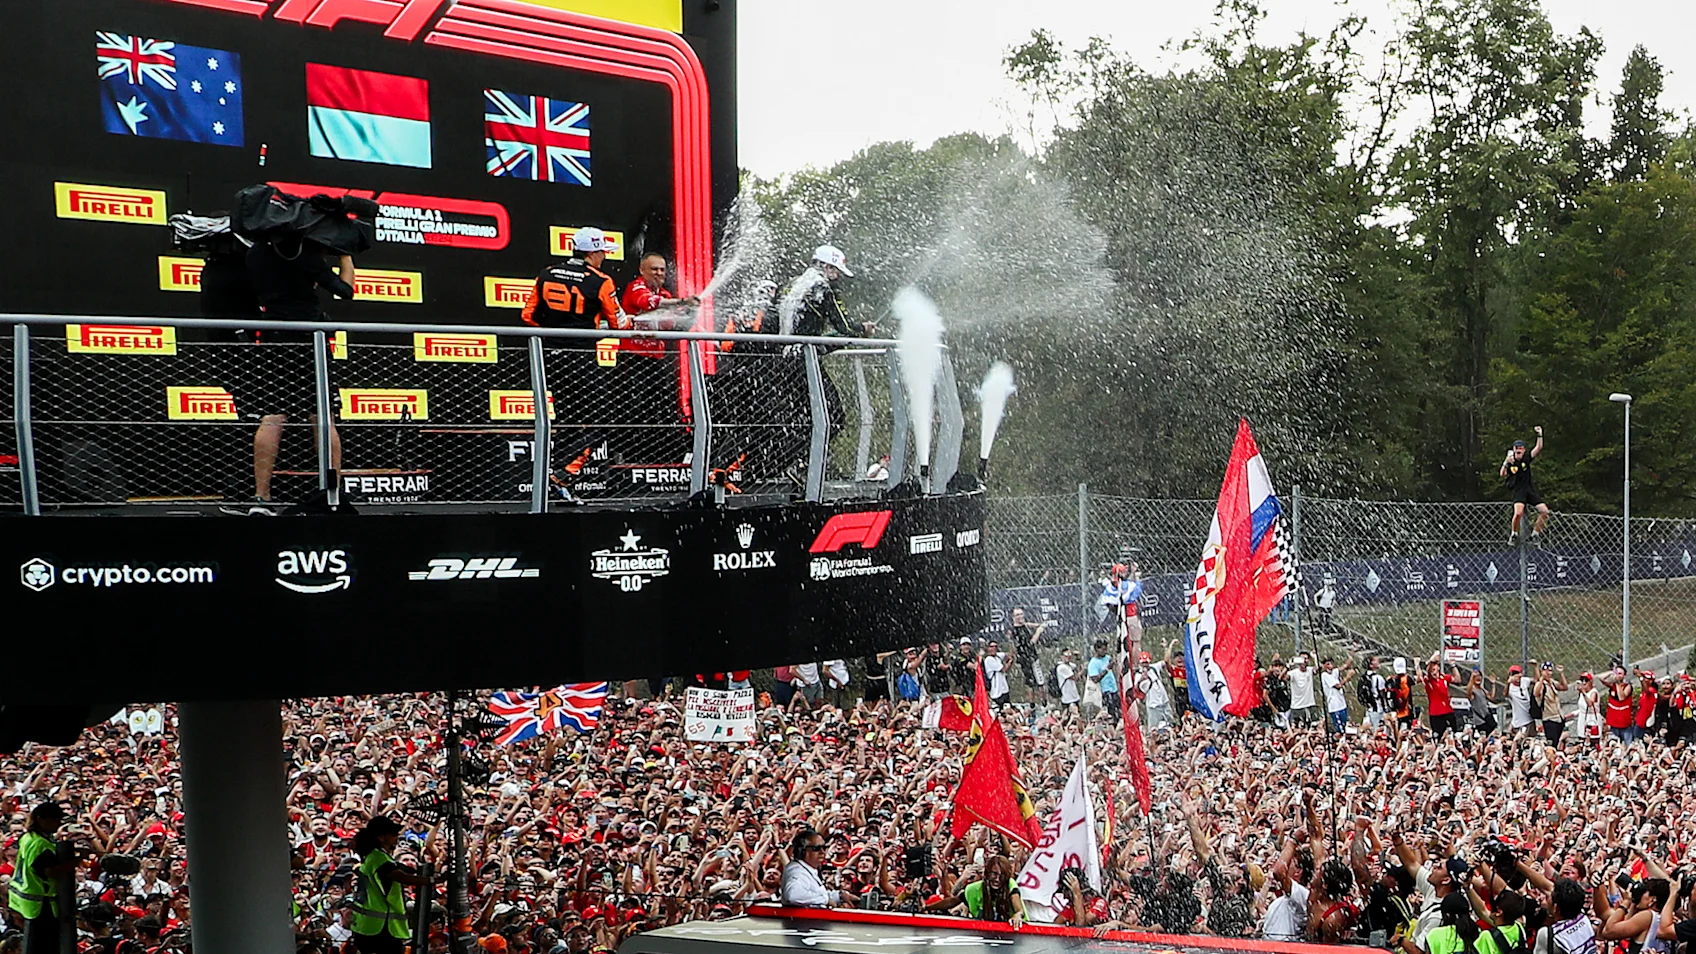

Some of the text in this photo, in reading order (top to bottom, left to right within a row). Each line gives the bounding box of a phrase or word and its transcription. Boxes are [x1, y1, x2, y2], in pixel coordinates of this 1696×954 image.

[69, 190, 153, 218] PIRELLI
[375, 217, 498, 238] PIRELLI GRAN PREMIO
[495, 284, 533, 303] PIRE
[81, 324, 163, 349] PIRELLI
[425, 337, 487, 358] PIRELLI
[180, 392, 237, 414] PIREL
[350, 394, 417, 414] PIRELLI
[344, 475, 429, 493] FERRARI
[632, 469, 692, 484] FERRA
[910, 533, 943, 554] PIRELLI
[277, 550, 347, 574] aws
[426, 557, 524, 580] DHL
[595, 557, 664, 572] Heineken
[713, 550, 776, 571] ROLEX
[62, 564, 214, 586] crypto.com
[620, 576, 641, 591] 0.0
[688, 722, 706, 734] 55
